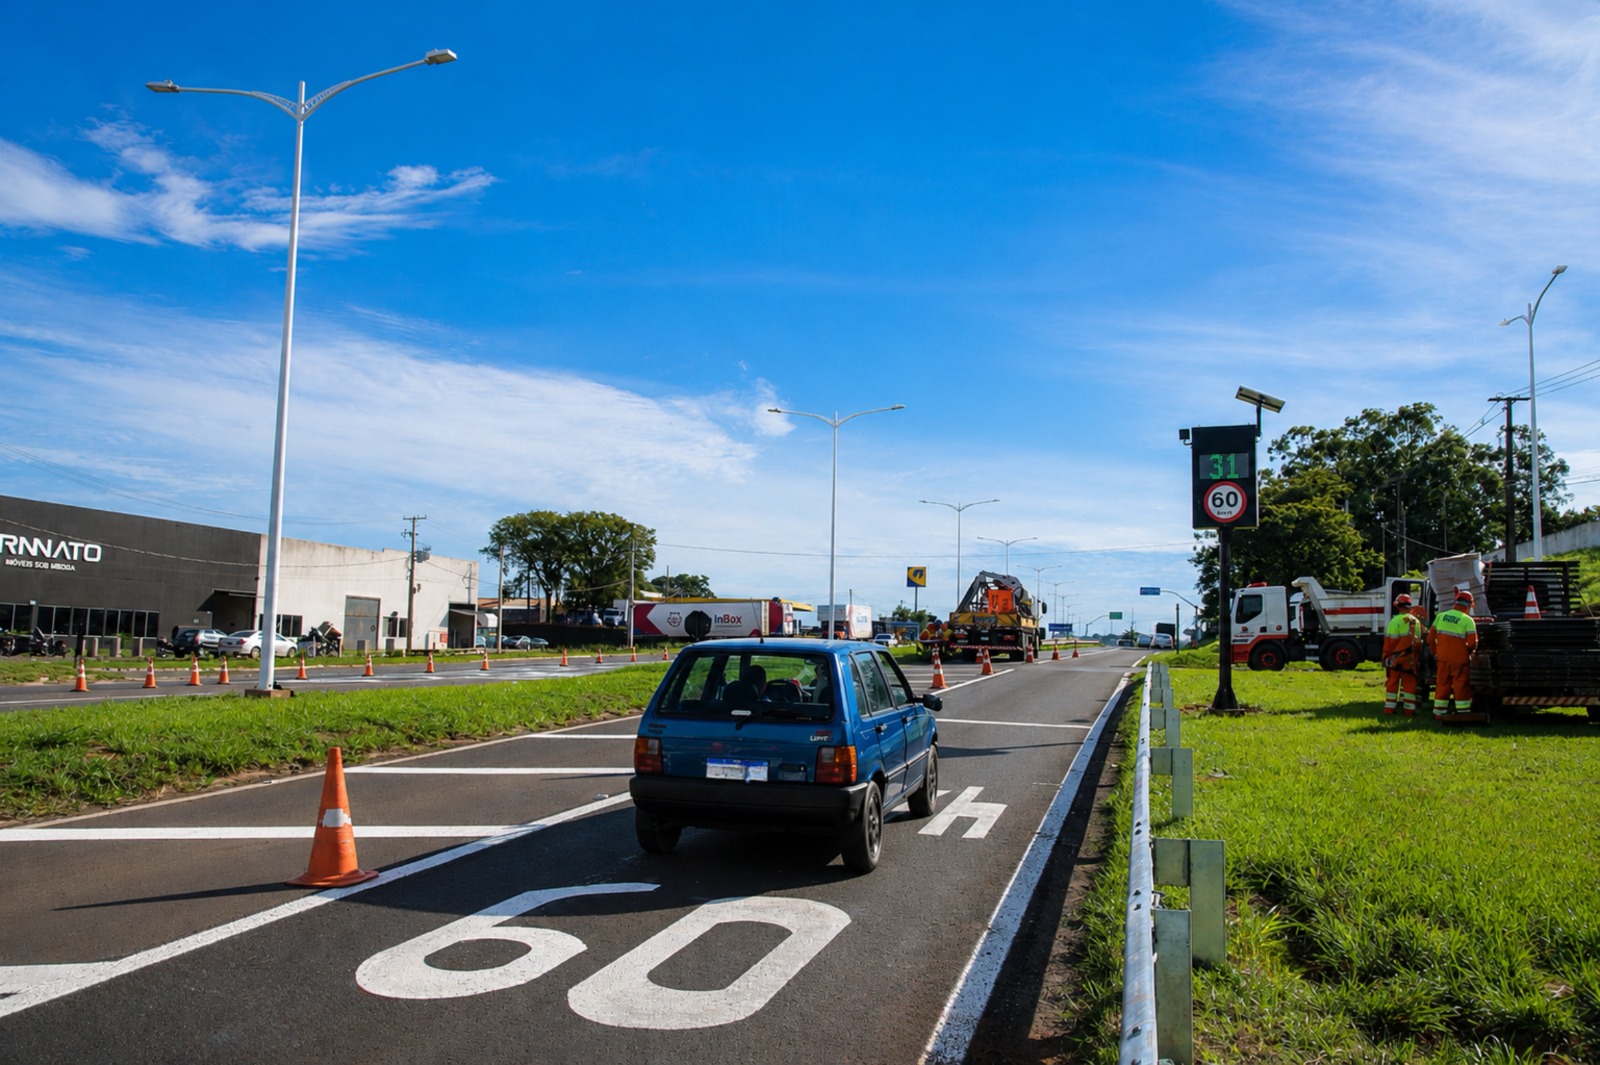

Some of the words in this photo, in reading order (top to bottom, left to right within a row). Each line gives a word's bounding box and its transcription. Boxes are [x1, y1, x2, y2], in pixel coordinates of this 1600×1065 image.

[1209, 453, 1239, 480] 31
[1212, 491, 1238, 508] 60
[714, 614, 742, 624] InBox
[355, 882, 851, 1030] 60
